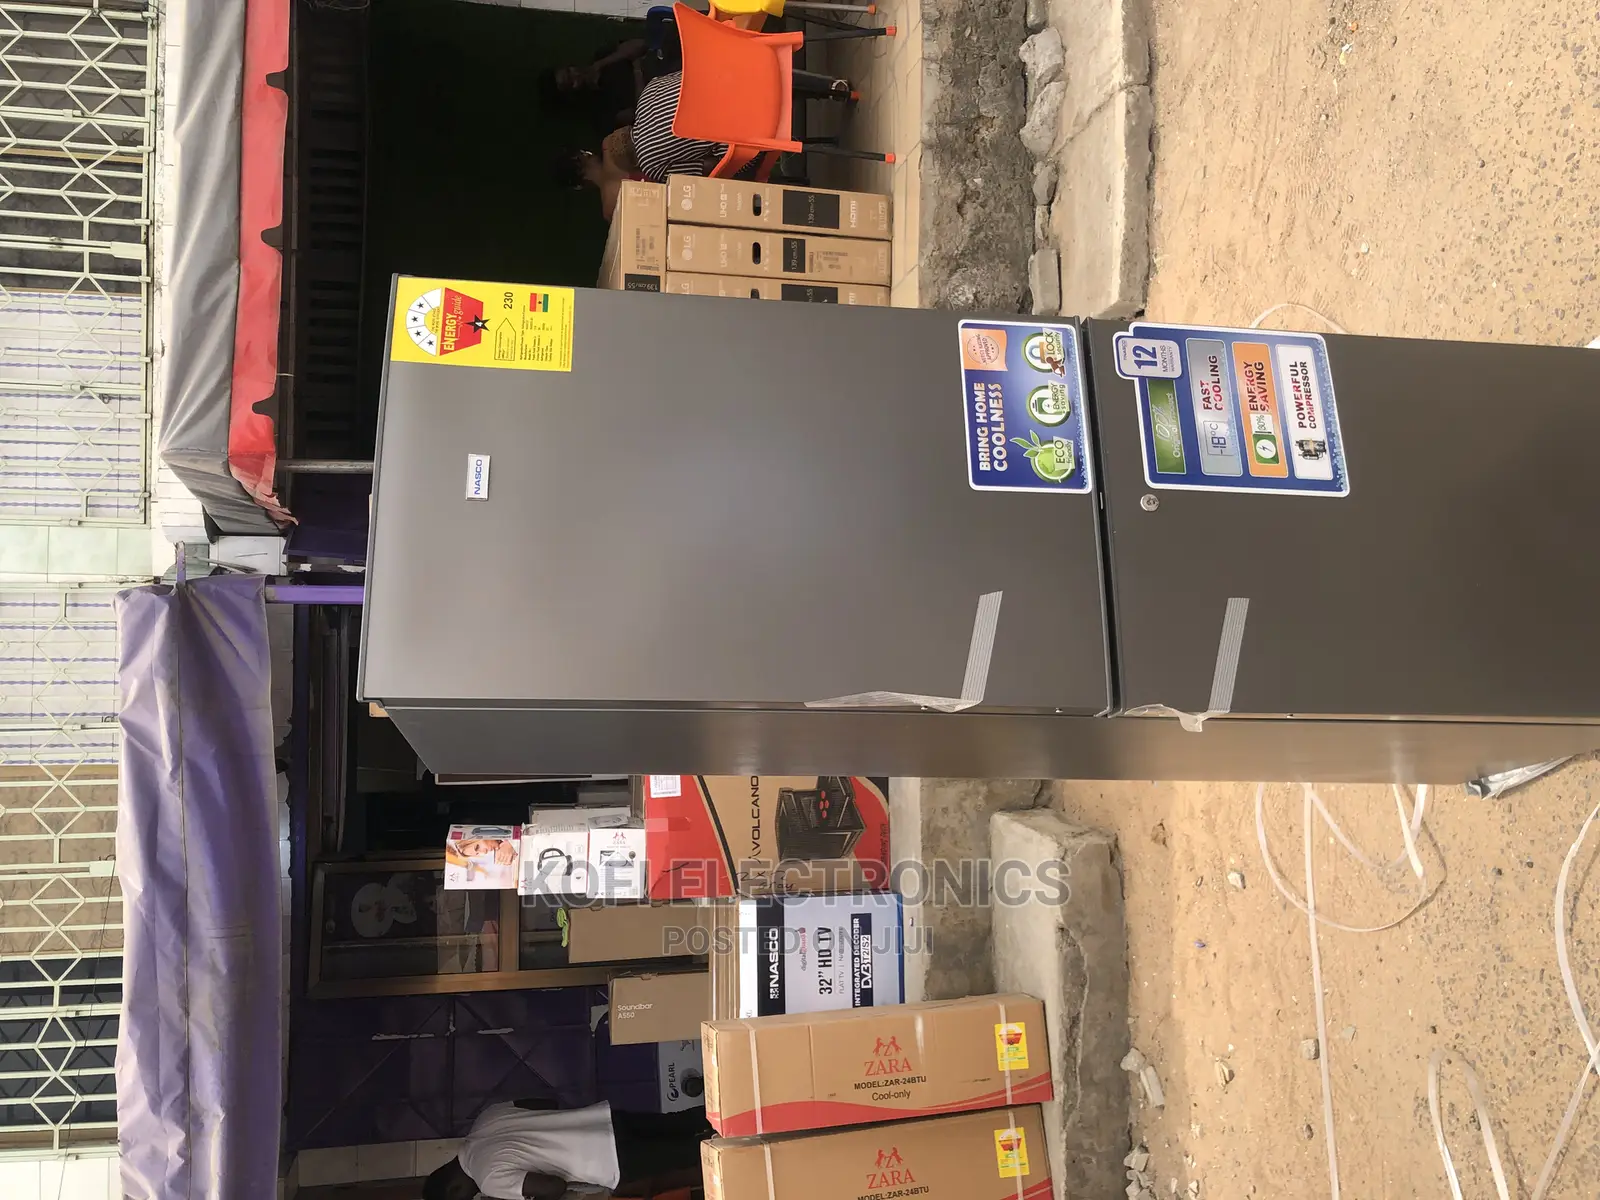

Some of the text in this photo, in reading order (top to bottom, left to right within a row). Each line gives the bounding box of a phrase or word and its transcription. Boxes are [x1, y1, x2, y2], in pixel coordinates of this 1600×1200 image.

[683, 185, 691, 198] LG
[683, 236, 691, 248] LG
[503, 292, 513, 309] 230
[681, 283, 689, 294] LG
[441, 296, 463, 351] ENERGY guide
[982, 338, 991, 360] APPROVED
[1045, 333, 1055, 355] LOCK
[1054, 332, 1062, 356] security
[1132, 345, 1157, 369] 12
[1160, 345, 1168, 372] MONTHS
[1200, 380, 1212, 410] FAST
[1209, 355, 1224, 411] COOLING
[1243, 361, 1259, 411] ENERGY
[1254, 361, 1270, 412] SAVING
[1289, 361, 1307, 429] POWERFUL
[1300, 361, 1317, 429] COMPRESSOR
[1051, 383, 1060, 410] ENERGY
[974, 382, 991, 471] BRING HOME
[989, 383, 1008, 472] COOLNESS
[1054, 440, 1065, 464] ECO
[1065, 441, 1073, 464] friendly
[1169, 425, 1180, 458] Original
[474, 459, 482, 495] NASCO
[751, 776, 761, 851] VOLCANO
[818, 927, 831, 943] TV
[769, 928, 779, 987] NASCO
[818, 949, 832, 967] HD
[839, 970, 844, 978] TV
[883, 1045, 892, 1056] Z
[864, 1057, 912, 1076] ZARA
[872, 1090, 911, 1101] Cool-only
[884, 1156, 894, 1168] Z
[866, 1168, 916, 1189] ZARA
